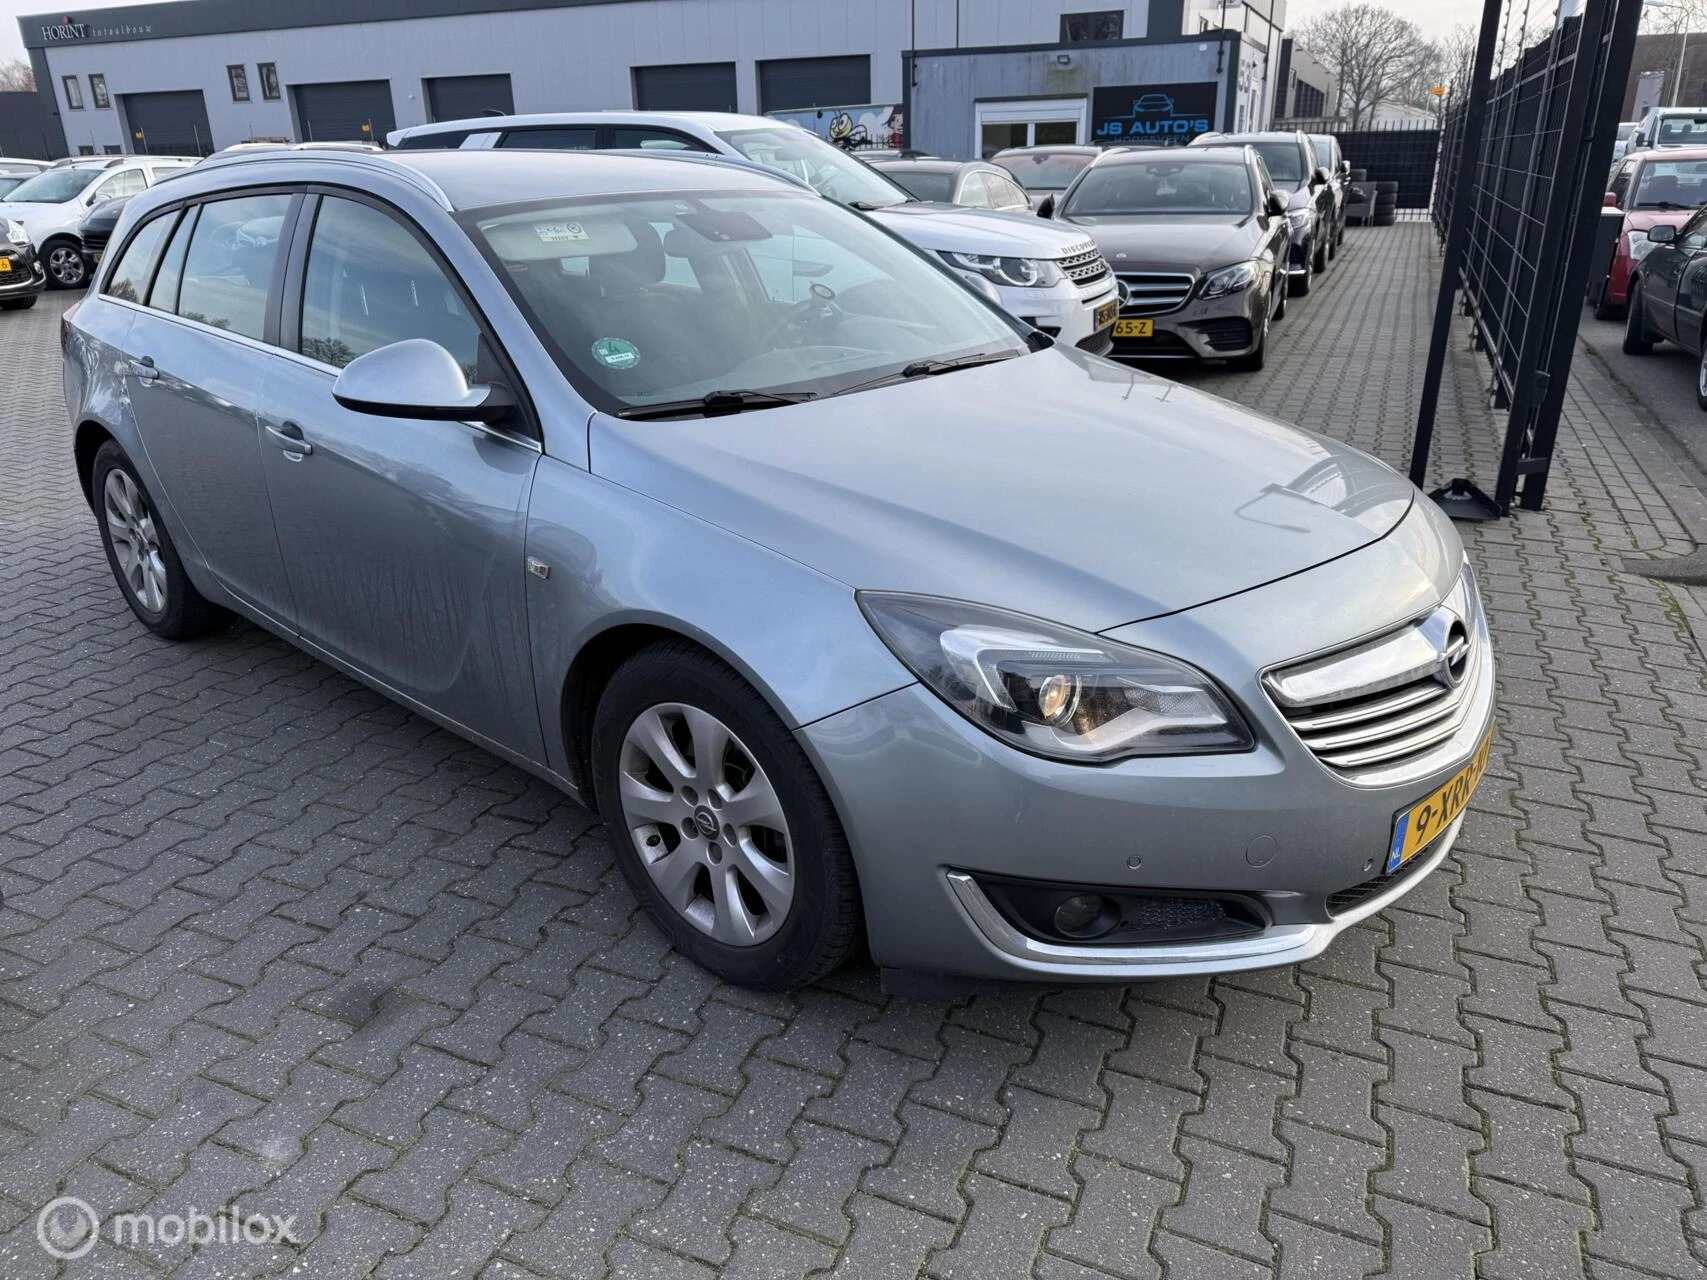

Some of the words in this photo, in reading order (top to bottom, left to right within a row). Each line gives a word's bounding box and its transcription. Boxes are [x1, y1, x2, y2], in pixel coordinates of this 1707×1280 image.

[41, 24, 85, 40] HORINT
[1097, 122, 1123, 135] JS
[1129, 119, 1209, 134] AUTO'S
[1115, 321, 1148, 335] 65-Z
